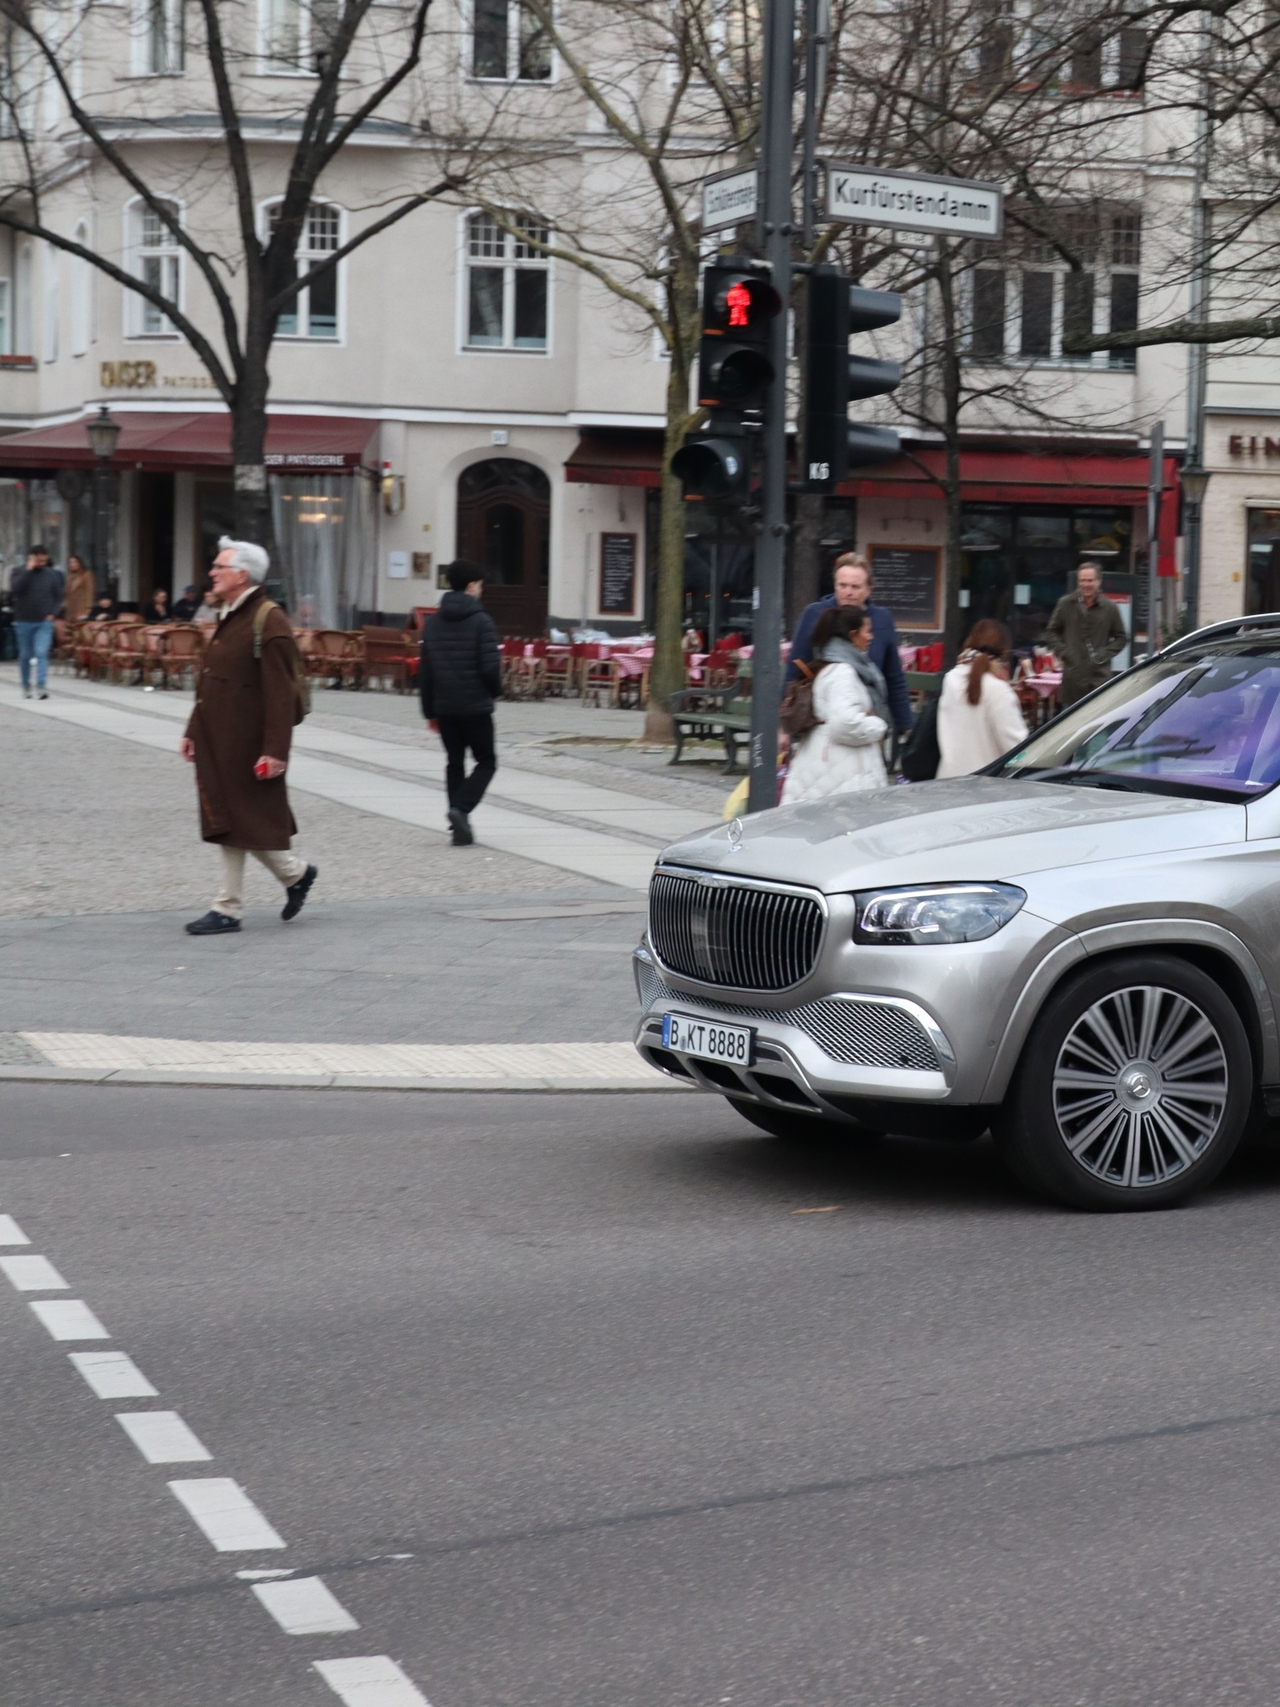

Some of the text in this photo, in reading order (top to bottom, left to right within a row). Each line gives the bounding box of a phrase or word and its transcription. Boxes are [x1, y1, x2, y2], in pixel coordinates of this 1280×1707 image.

[835, 177, 991, 221] Kurfürstendamm
[670, 1020, 745, 1059] B KT 8888
